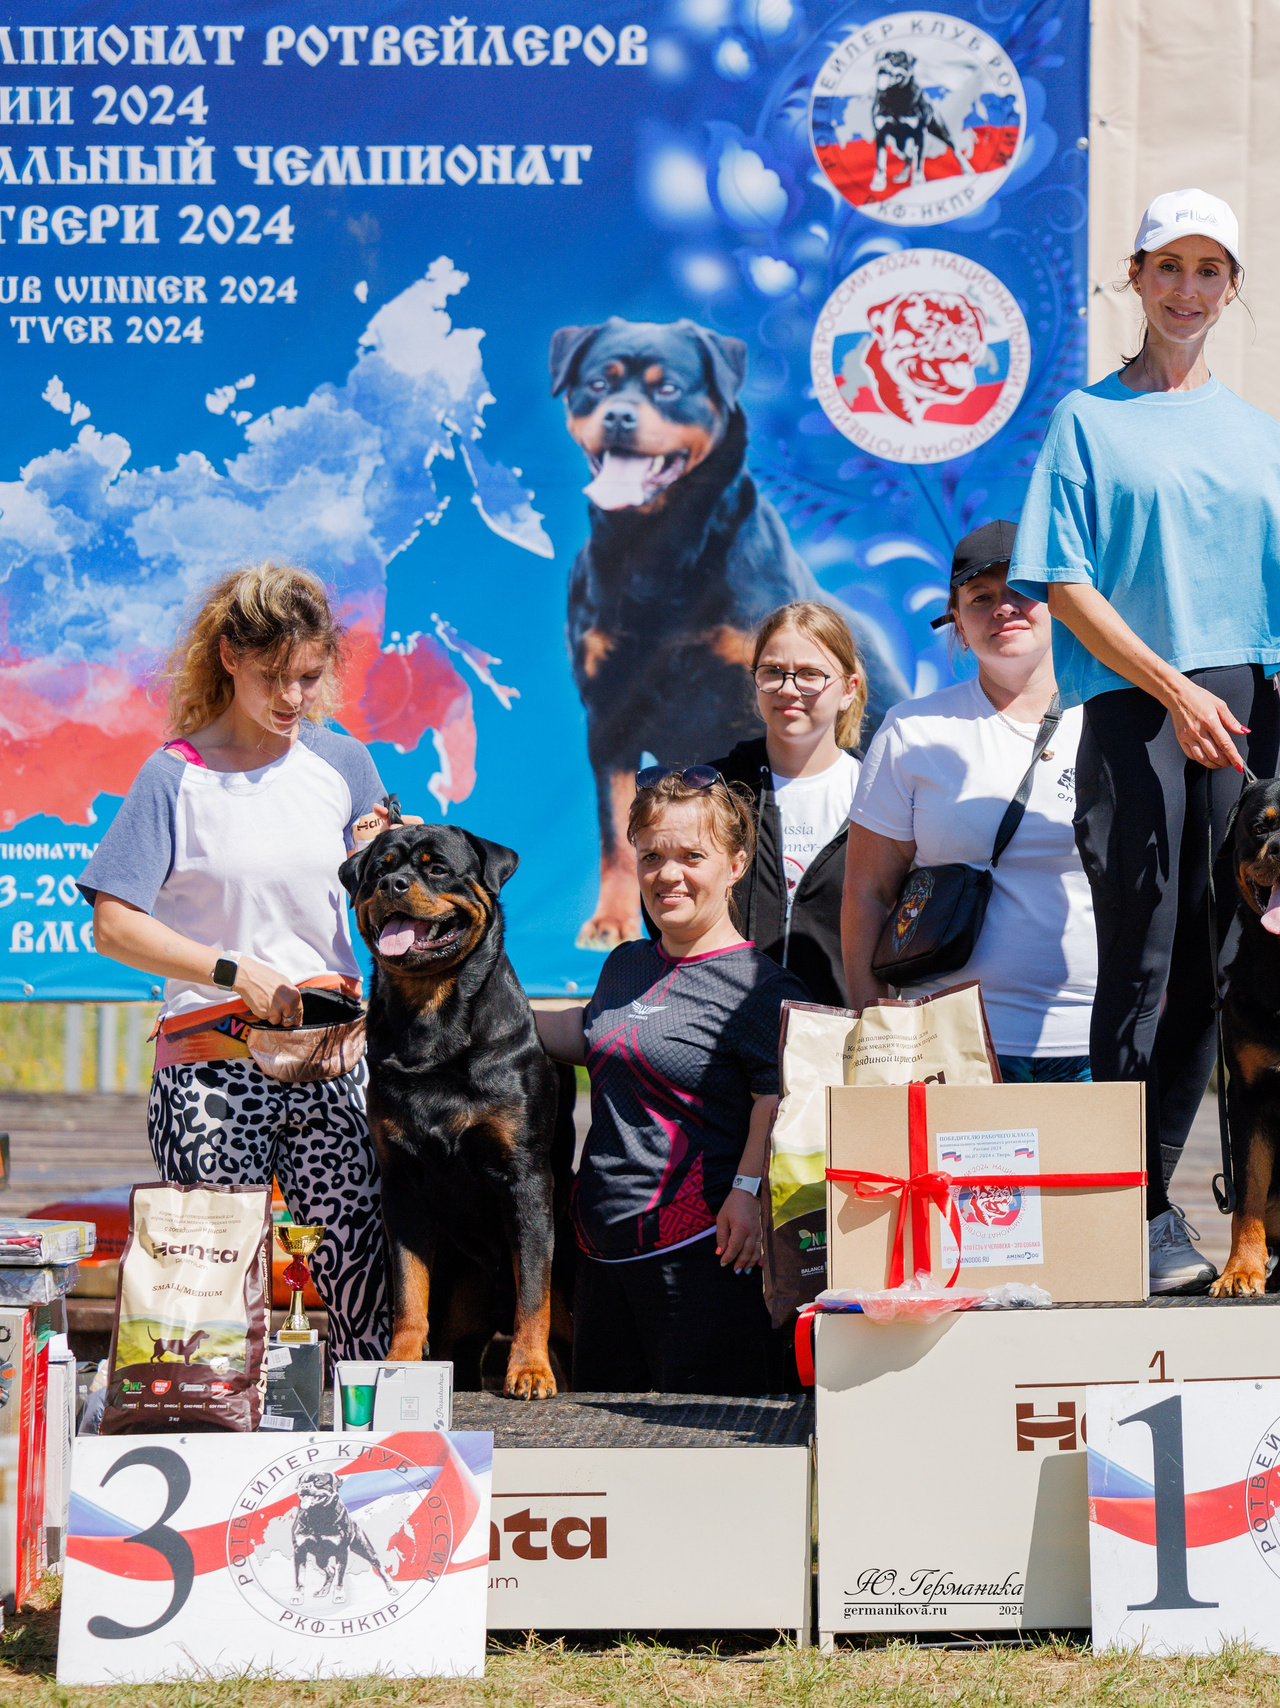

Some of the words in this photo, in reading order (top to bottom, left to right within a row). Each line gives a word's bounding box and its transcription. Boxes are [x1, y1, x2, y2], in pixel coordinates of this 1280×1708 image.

[263, 16, 649, 67] РОТВЕЙЛЕРОВ
[911, 20, 980, 52] КЛУБ
[93, 85, 209, 125] 2024
[234, 145, 593, 185] ЧЕМПИОНАТ
[179, 205, 294, 245] 2024
[1175, 208, 1218, 227] FILA
[55, 276, 208, 304] WINNER
[220, 276, 298, 304] 2024
[11, 316, 114, 344] TVER
[127, 316, 204, 344] 2024
[151, 1241, 239, 1264] Hanta
[152, 1282, 223, 1298] SMALL/MEDIUM
[230, 1447, 320, 1586] РОТВЕЙЛЕР
[338, 1444, 413, 1475] КЛУБ
[416, 1479, 449, 1585] РОССИИ
[1117, 1394, 1219, 1611] 1
[87, 1445, 195, 1640] 3
[278, 1603, 401, 1635] РКФ-НКПР
